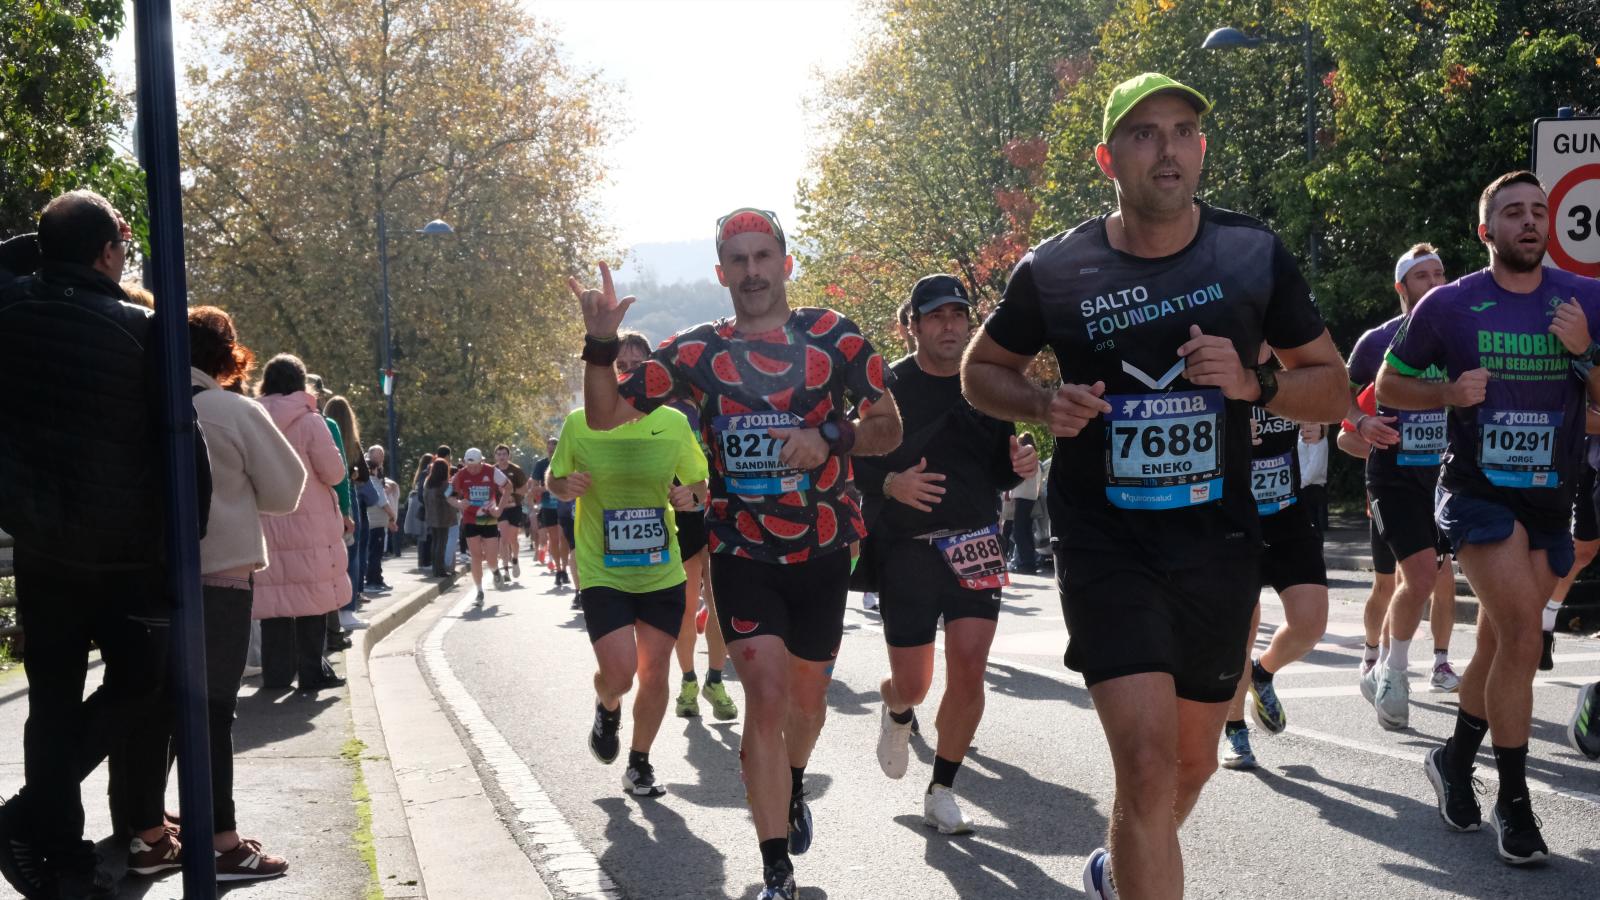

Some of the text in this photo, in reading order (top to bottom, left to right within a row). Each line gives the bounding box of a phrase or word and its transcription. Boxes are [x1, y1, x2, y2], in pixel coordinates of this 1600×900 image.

[1080, 285, 1149, 318] SALTO
[1085, 283, 1225, 340] FOUNDATION
[1094, 339, 1115, 352] .org
[1480, 355, 1504, 370] SAN
[1115, 421, 1213, 459] 7688
[1405, 426, 1444, 441] 1098
[1486, 430, 1550, 452] 10291
[726, 433, 787, 457] 827
[1142, 461, 1193, 475] ENEKO
[1506, 455, 1534, 463] JORGE
[611, 523, 663, 540] 11255
[952, 539, 1000, 565] 4888
